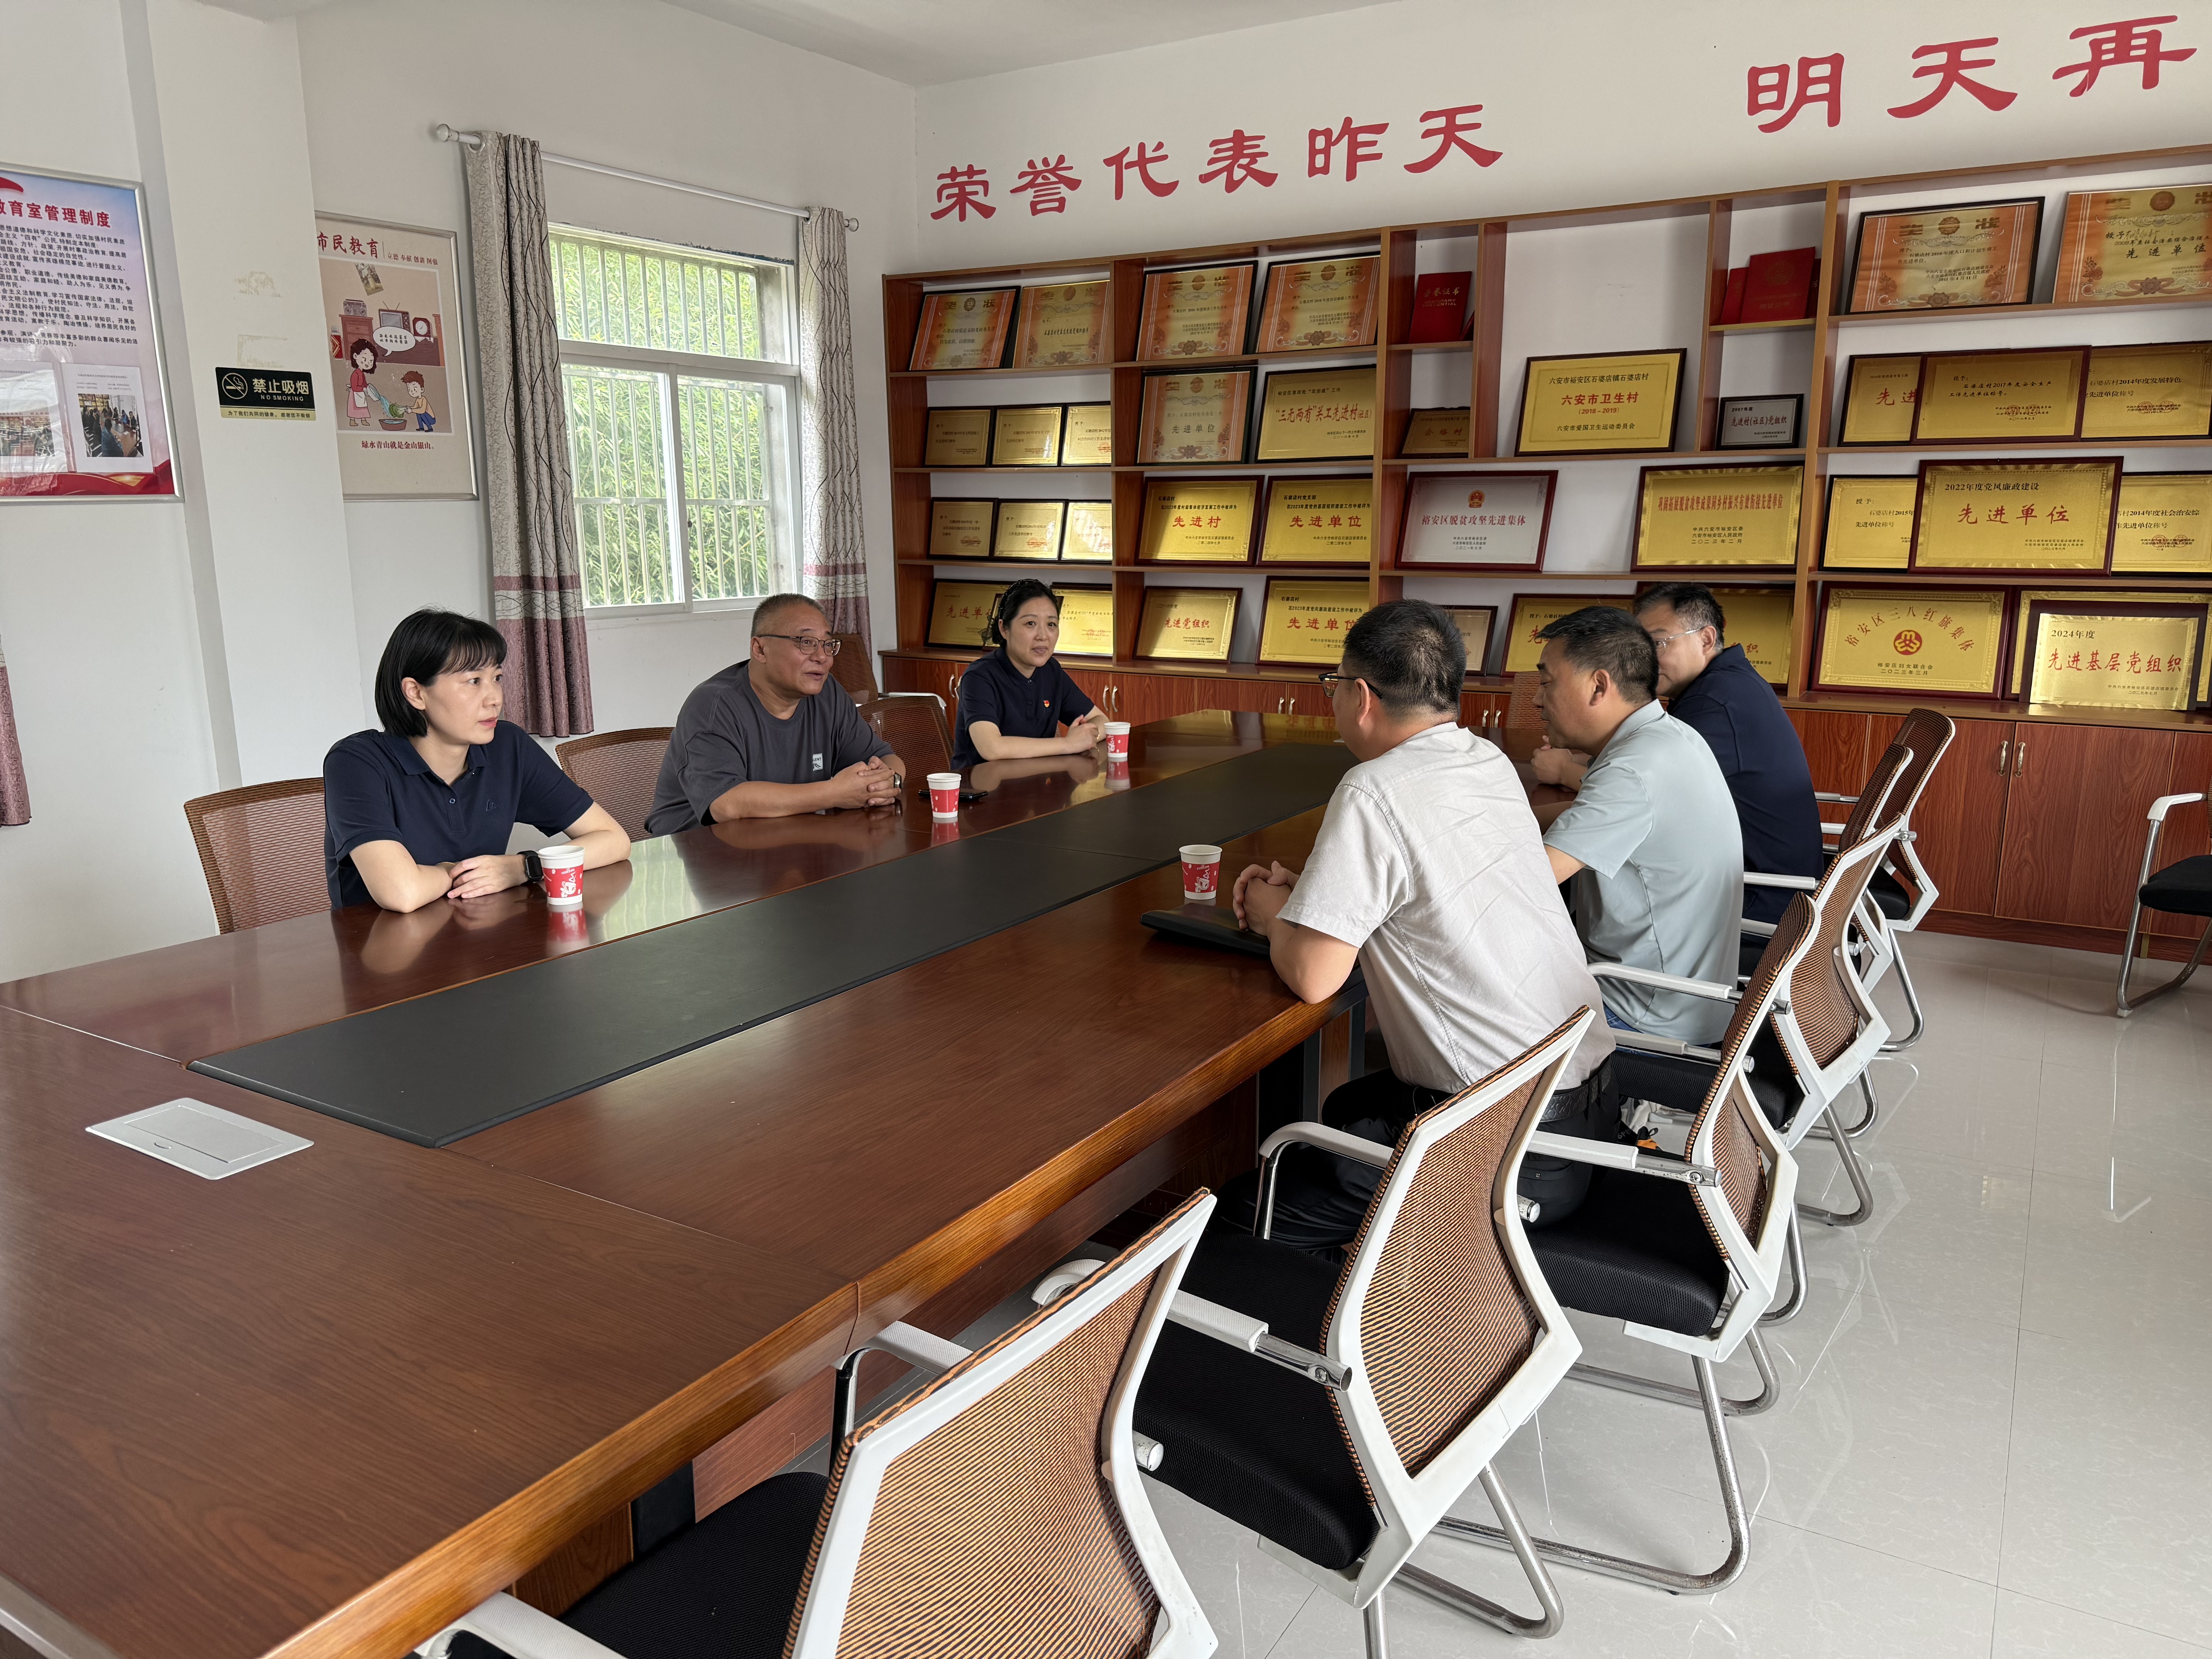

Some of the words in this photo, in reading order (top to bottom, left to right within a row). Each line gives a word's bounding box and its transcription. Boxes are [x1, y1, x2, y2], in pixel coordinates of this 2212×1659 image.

[930, 104, 1503, 222] 荣誉代表昨天
[1747, 15, 2196, 133] 明天再
[317, 231, 379, 259] 市民教育
[2126, 243, 2206, 259] 先进单位
[1549, 373, 1649, 385] 六安市裕安区石婆店镇石婆店村
[252, 378, 309, 395] 禁止吸烟
[1561, 392, 1639, 405] 六安市卫生村
[1172, 424, 1215, 434] 先进单位
[1557, 422, 1635, 432] 六安市爱国卫生运动委员会
[1944, 483, 2039, 491] 2022年度党风廉政建设
[1422, 515, 1526, 526] 裕安区脱贫攻坚先进集体
[1957, 503, 2069, 526] 先进单位
[1172, 515, 1221, 528] 先进村
[1289, 515, 1362, 528] 先进单位
[1164, 617, 1209, 629] 先进党组织
[1287, 617, 1356, 631] 先进单位
[1844, 605, 1975, 651] 裕安区三八红旗集体
[2051, 630, 2095, 639] 2024年度
[2048, 648, 2182, 674] 先进基层党组织
